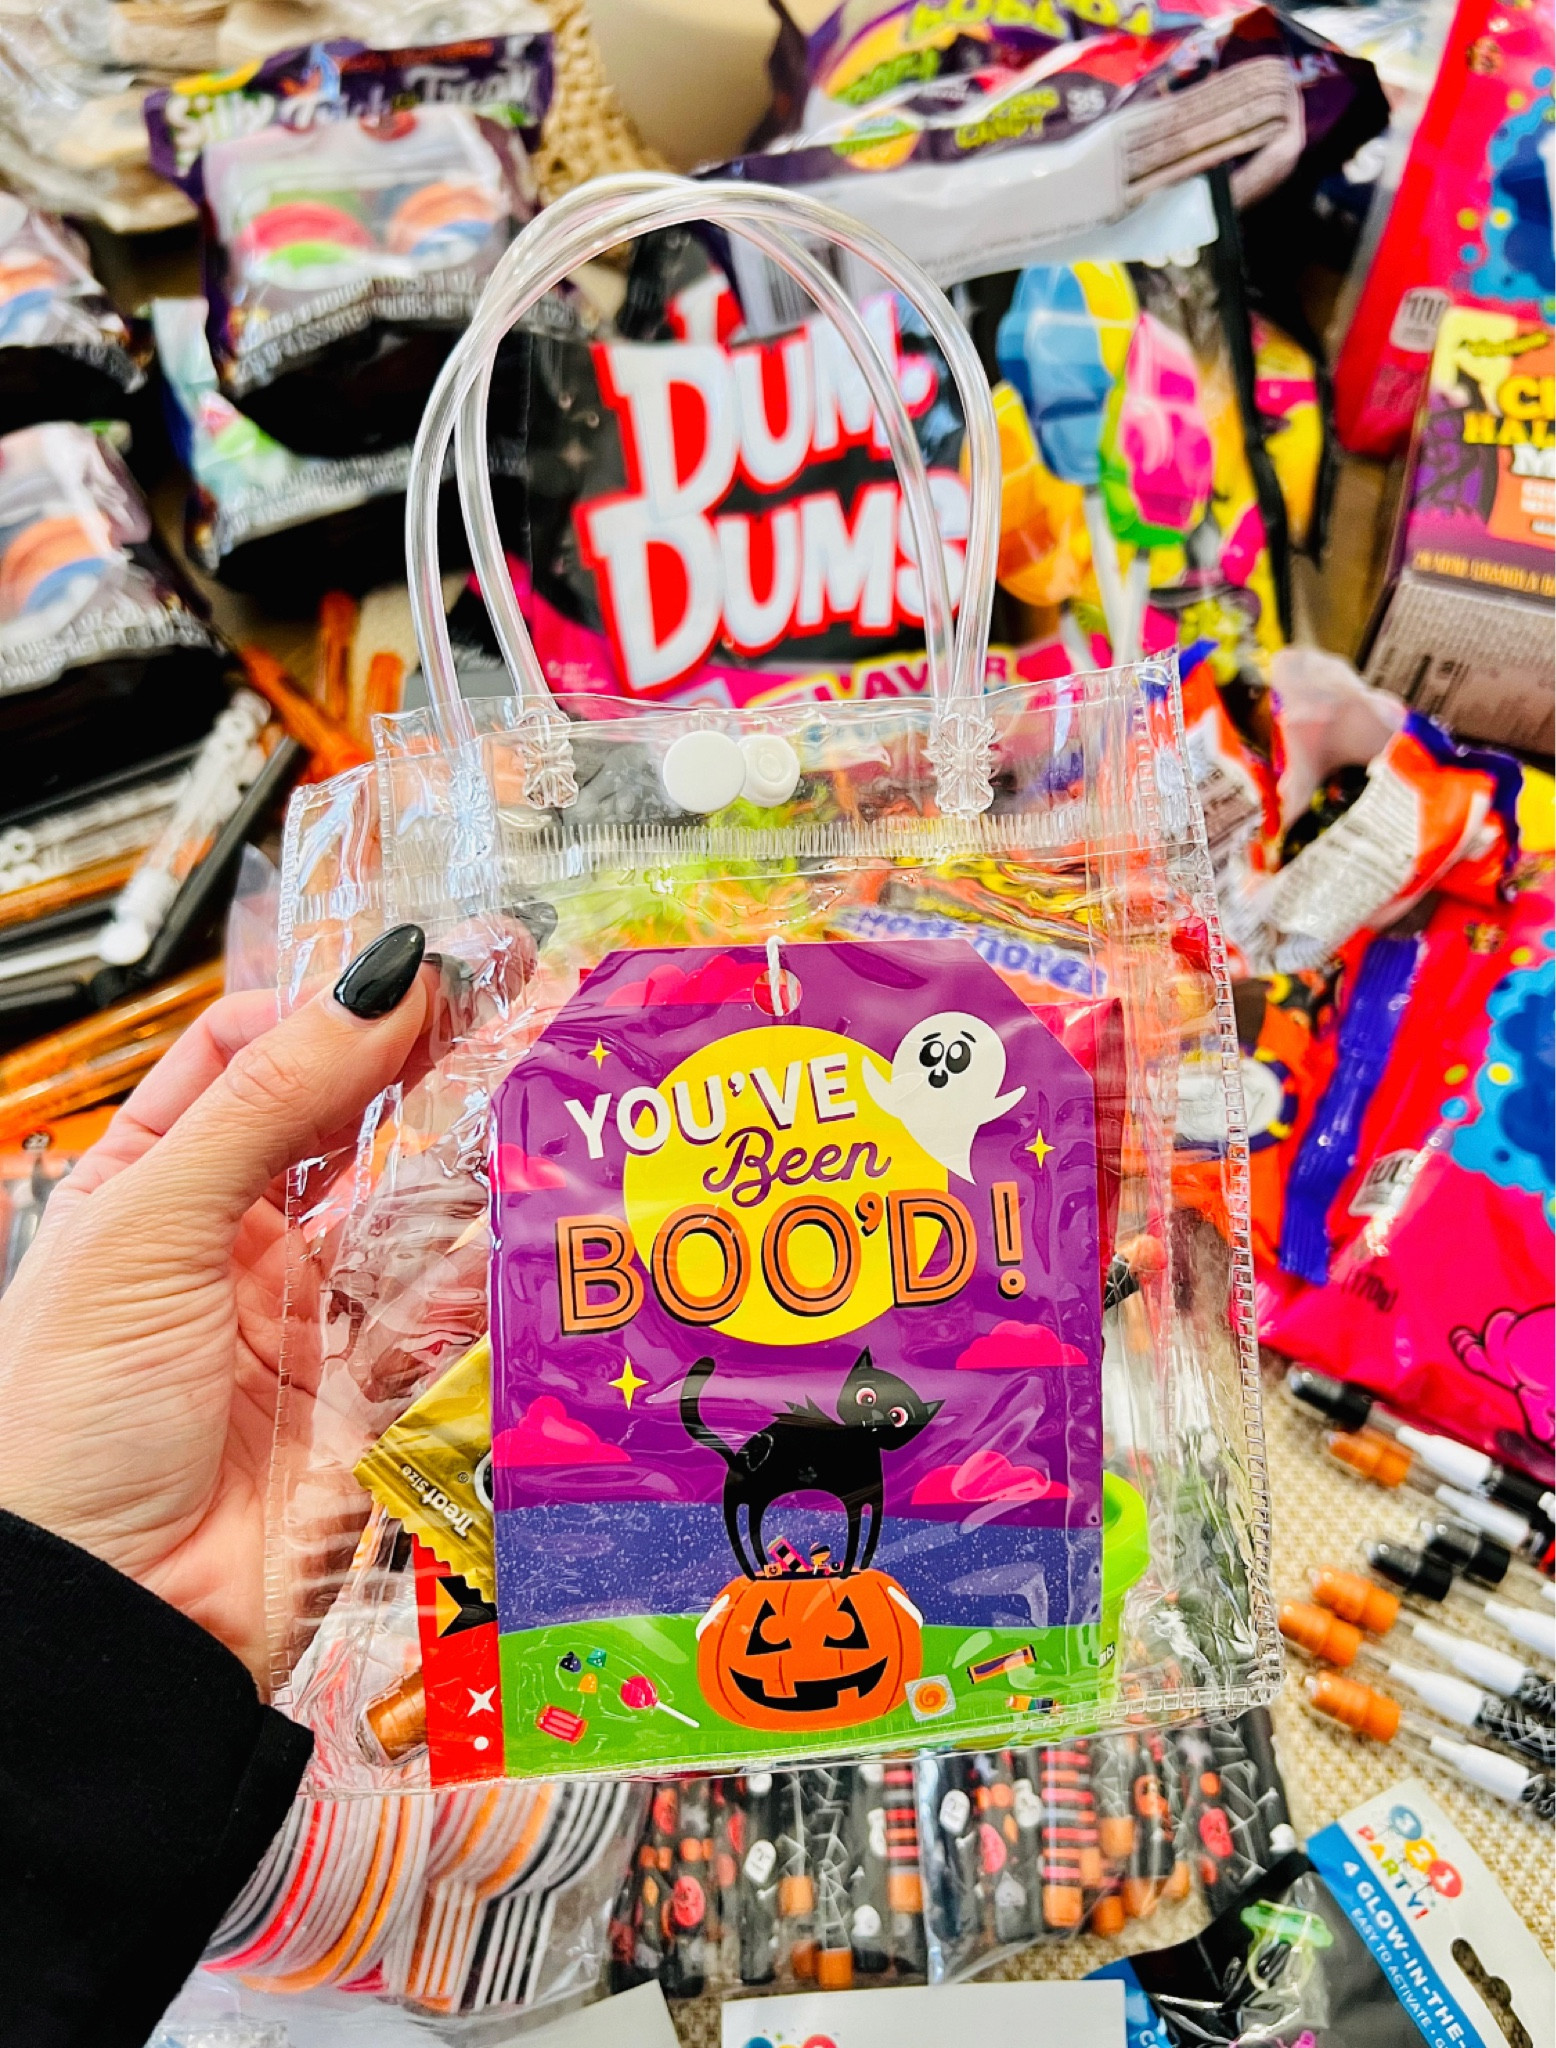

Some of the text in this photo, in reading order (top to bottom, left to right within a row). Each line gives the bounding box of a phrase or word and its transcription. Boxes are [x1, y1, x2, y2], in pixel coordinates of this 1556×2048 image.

[574, 468, 972, 692] DUMS
[564, 1052, 858, 1160] YOU'VE
[702, 1126, 893, 1208] Been
[402, 1465, 474, 1538] Treat size
[1343, 1860, 1360, 1878] 4
[1351, 1906, 1381, 1942] EASY
[1375, 1943, 1393, 1963] TO
[1387, 1964, 1433, 2028] ACTIVATE
